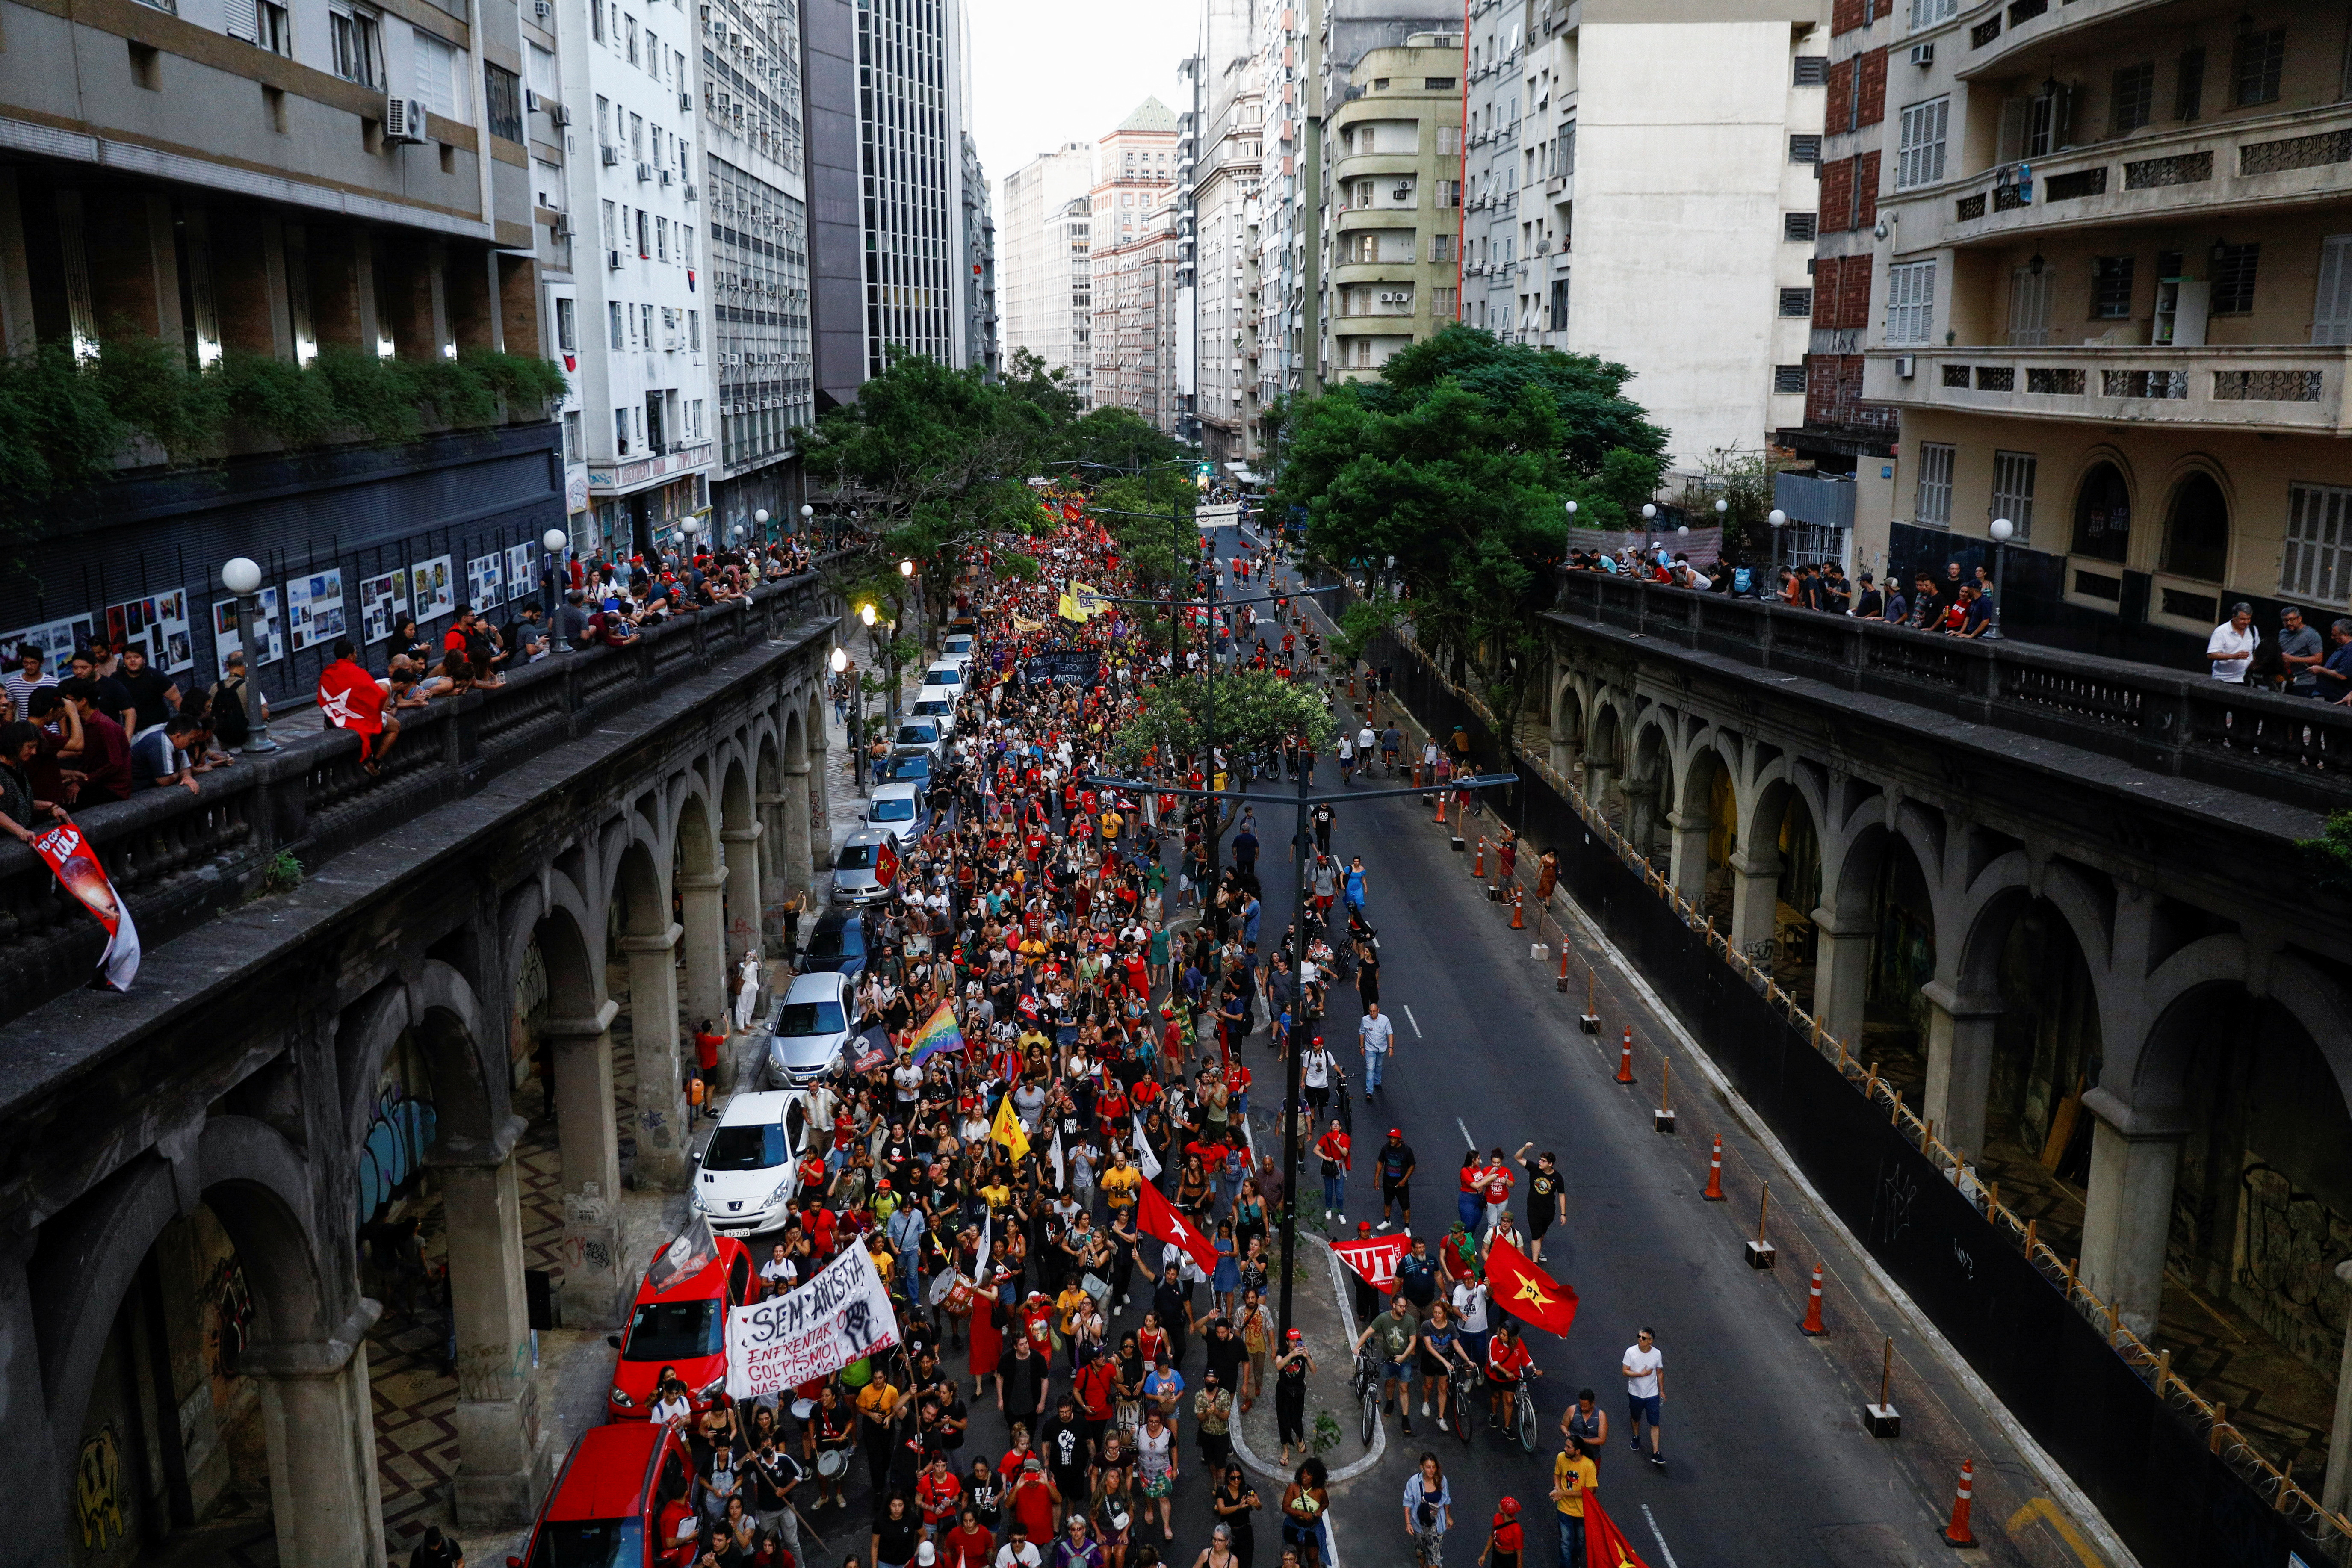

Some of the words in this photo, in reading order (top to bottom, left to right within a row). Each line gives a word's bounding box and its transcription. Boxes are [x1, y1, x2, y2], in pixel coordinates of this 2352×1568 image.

[1064, 508, 1078, 520] PSTU
[1031, 655, 1061, 667] PRISÃO
[1034, 666, 1050, 676] AOS
[1055, 662, 1099, 672] TERRORISTAS
[1030, 675, 1050, 683] SEM
[1053, 673, 1085, 683] ANISTIA!
[38, 838, 51, 853] TÔ
[52, 829, 80, 864] LULA
[1064, 1125, 1077, 1134] PWR
[752, 1295, 803, 1342] SEM
[813, 1249, 866, 1318] ANISTIA
[1526, 1285, 1539, 1300] PT
[748, 1322, 832, 1364] ENFRENTAR
[836, 1310, 846, 1329] O
[845, 1331, 895, 1366] ALICERCE
[748, 1344, 831, 1381] GOLPISMO
[751, 1380, 780, 1396] NAS
[783, 1362, 835, 1386] RUAS
